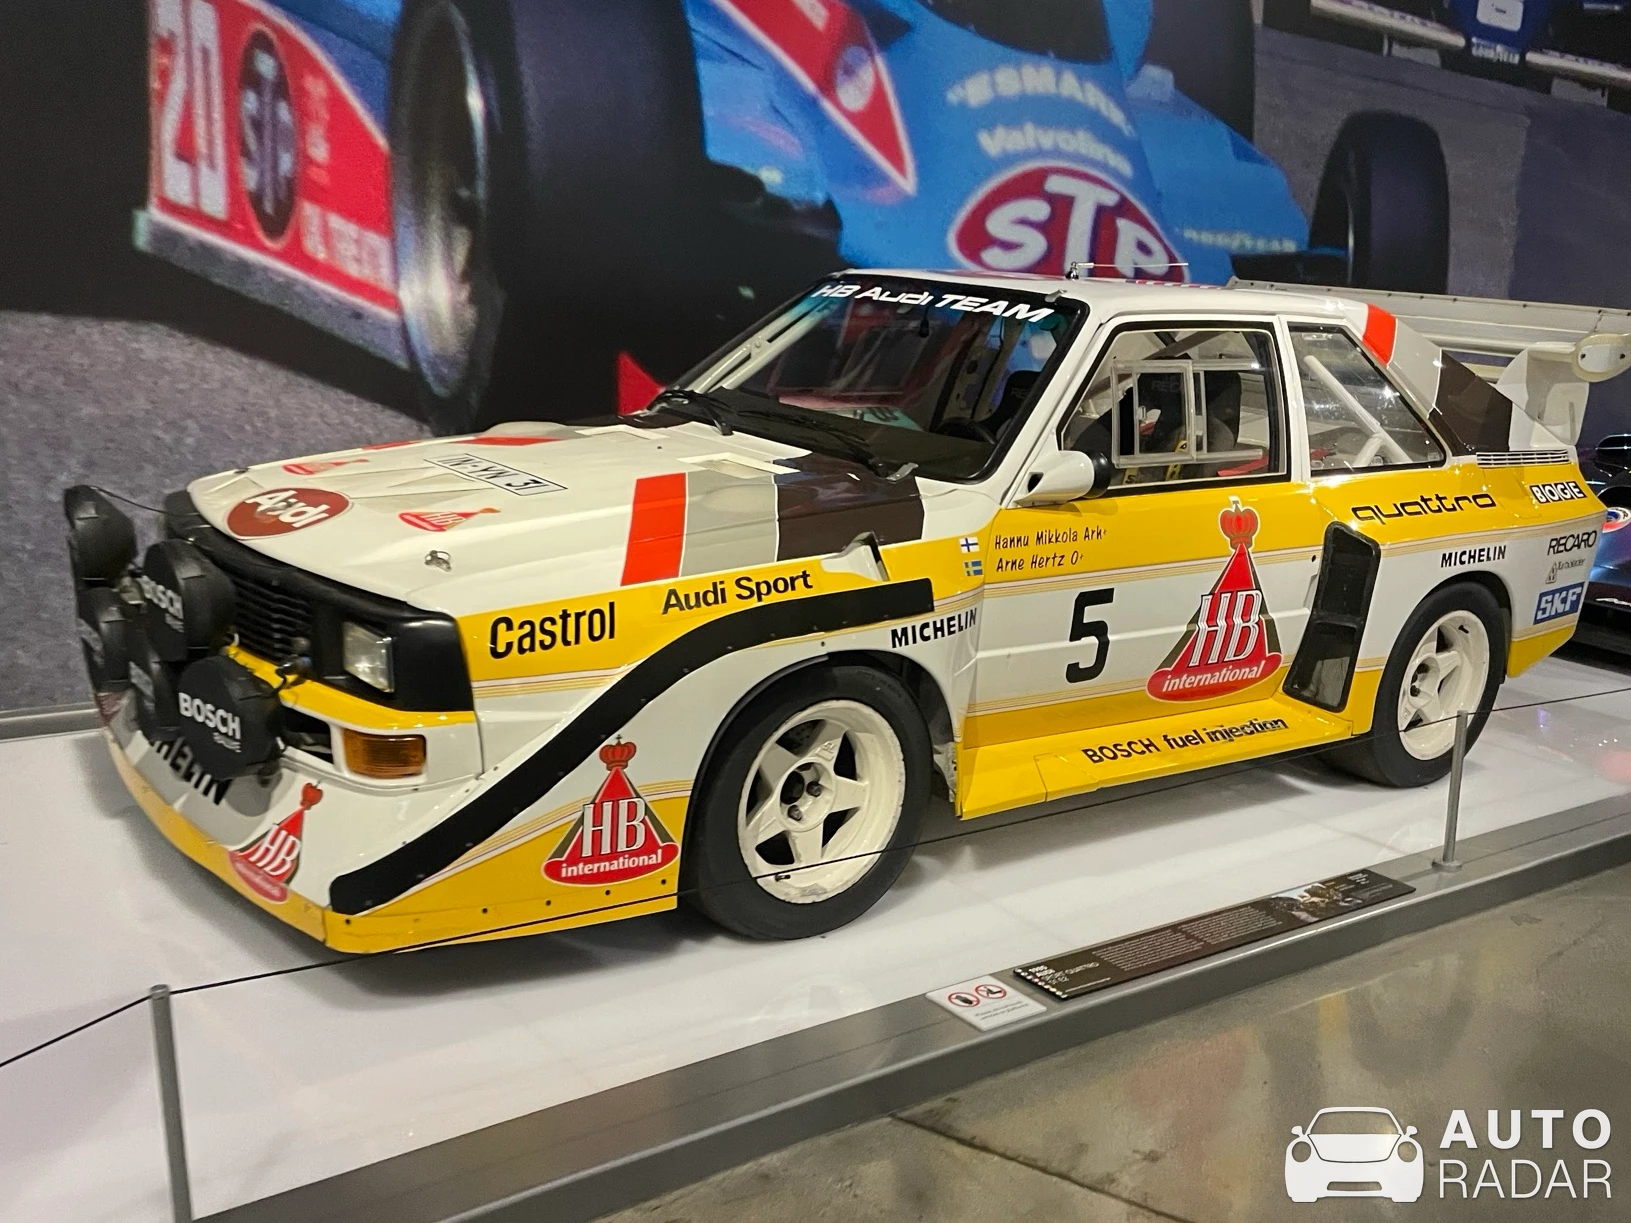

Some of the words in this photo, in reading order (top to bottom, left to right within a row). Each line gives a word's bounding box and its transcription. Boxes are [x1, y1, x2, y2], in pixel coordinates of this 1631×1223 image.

[979, 174, 1170, 278] STP
[811, 283, 856, 299] HB
[854, 286, 935, 306] Audi
[934, 293, 1056, 323] TEAM
[243, 490, 331, 528] Audi
[1351, 493, 1497, 525] quattro
[1532, 481, 1586, 503] BOGE
[994, 534, 1030, 550] Hannu
[1035, 527, 1079, 546] Mikkola
[1440, 545, 1508, 568] MICHELIN
[1547, 529, 1598, 557] RECARO
[996, 557, 1025, 573] Arne
[1030, 552, 1066, 569] Hertz
[660, 579, 728, 616] Audi
[735, 569, 813, 602] Sport
[1536, 586, 1584, 621] SKF
[489, 601, 616, 660] Castrol
[890, 607, 978, 649] MICHELIN
[1065, 587, 1115, 684] 5
[1185, 588, 1264, 668] HB
[1162, 659, 1267, 692] international
[178, 691, 242, 740] BOSCH
[1081, 737, 1162, 764] BOSCH
[1163, 729, 1206, 750] fuel
[1202, 717, 1290, 743] injection
[580, 796, 647, 858] HB
[248, 823, 302, 876] HB
[560, 848, 664, 878] international
